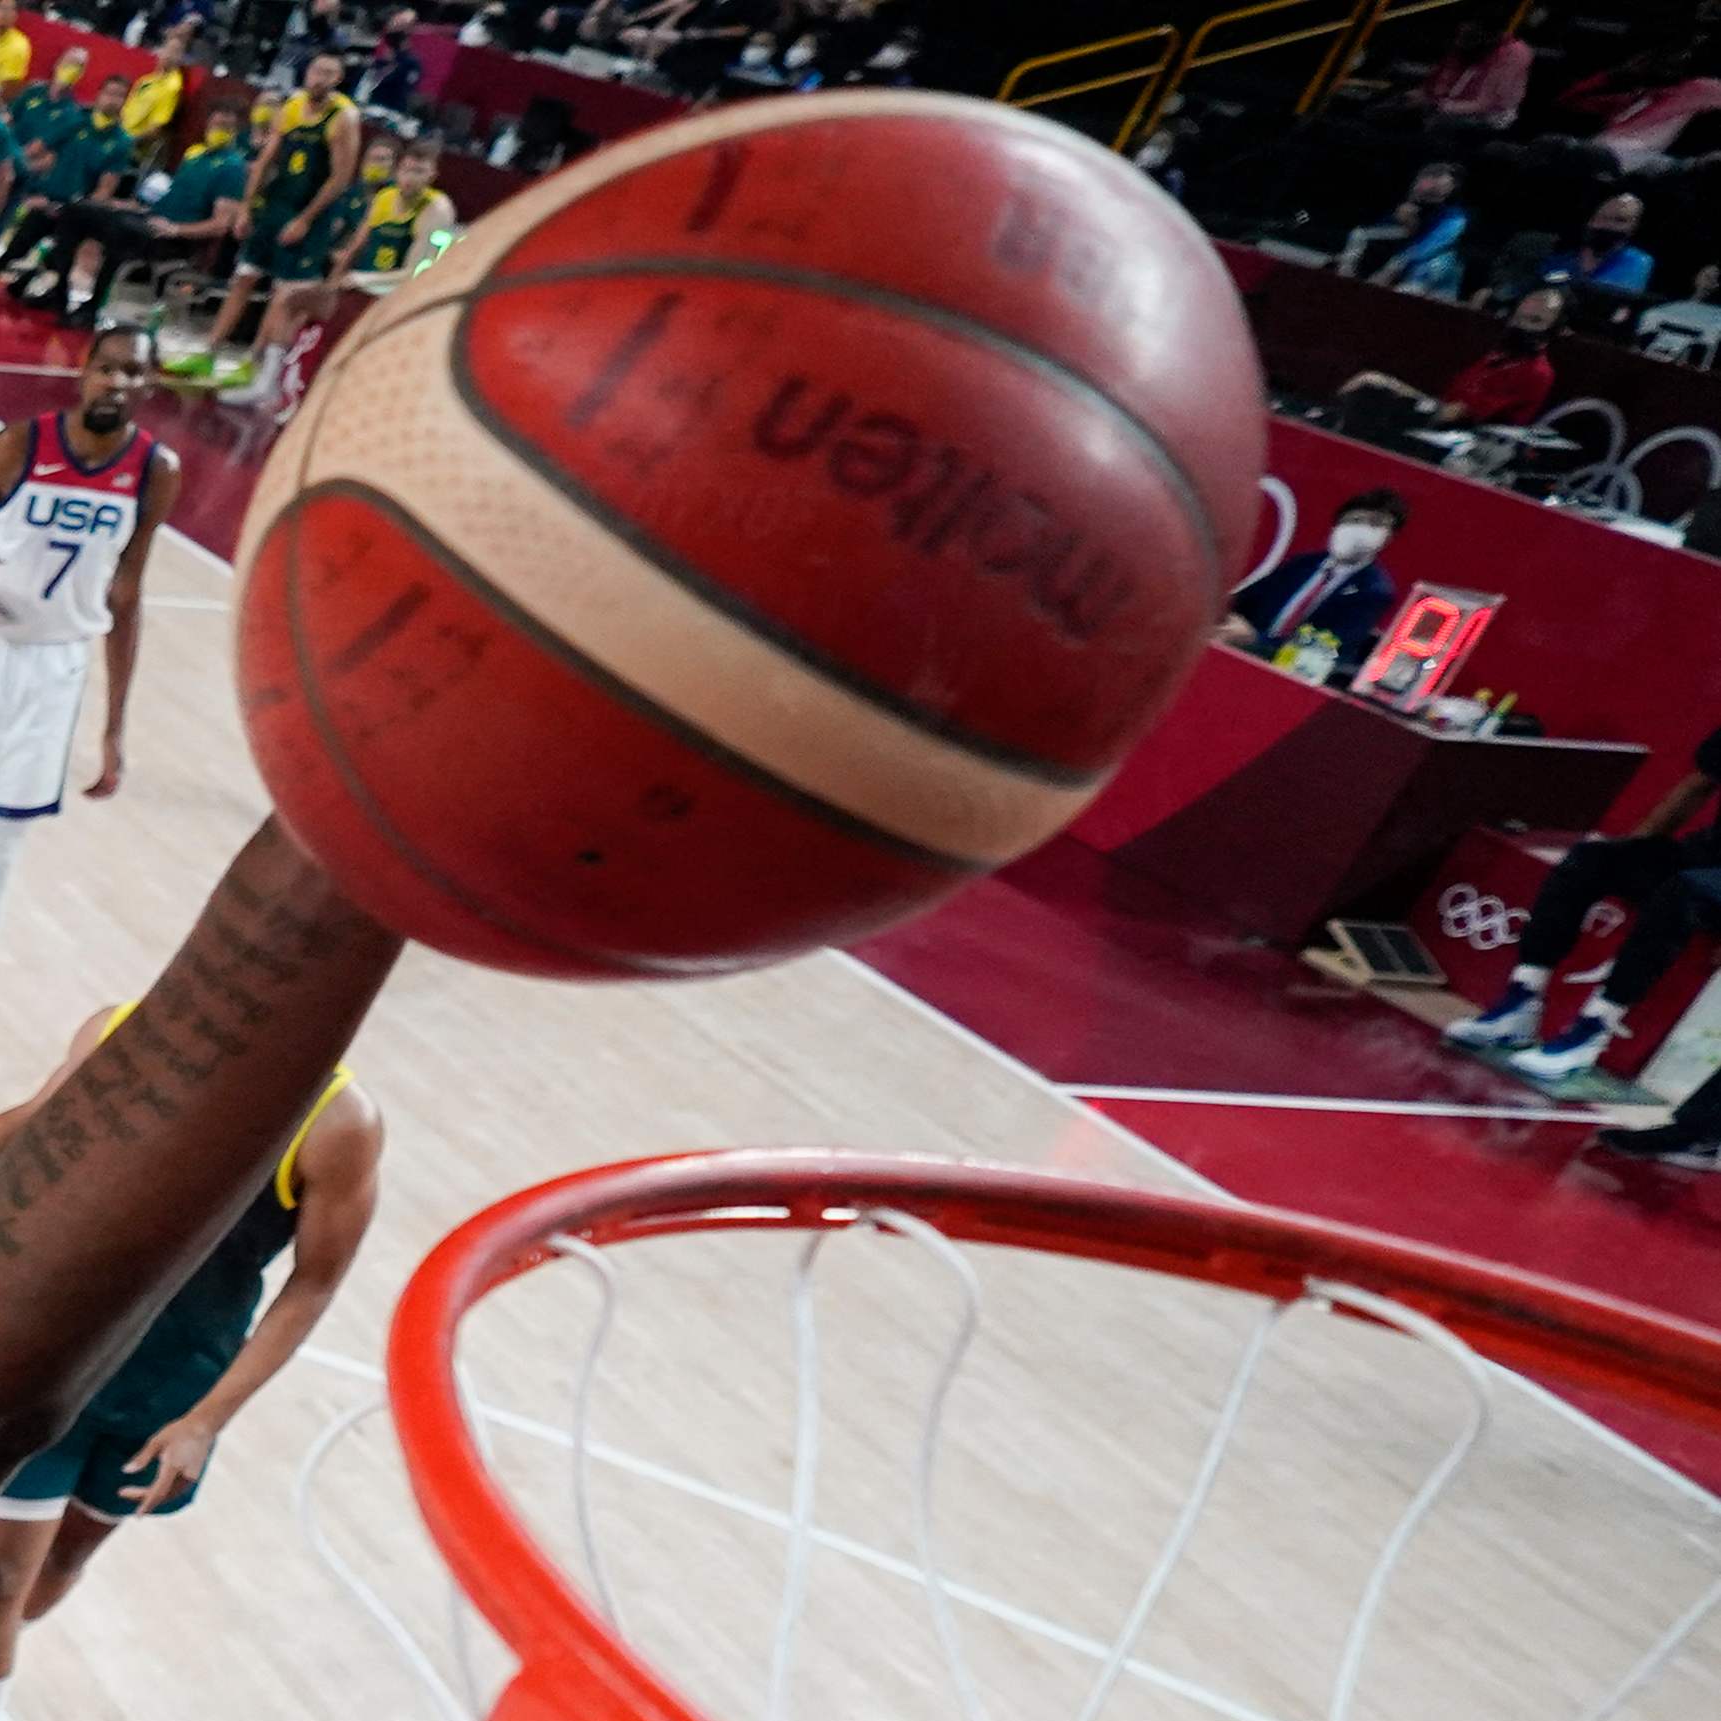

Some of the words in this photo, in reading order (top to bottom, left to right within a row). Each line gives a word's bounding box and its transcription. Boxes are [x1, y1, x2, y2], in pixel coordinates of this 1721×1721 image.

[25, 494, 124, 538] USA
[752, 372, 1141, 642] molten
[47, 539, 83, 600] 7
